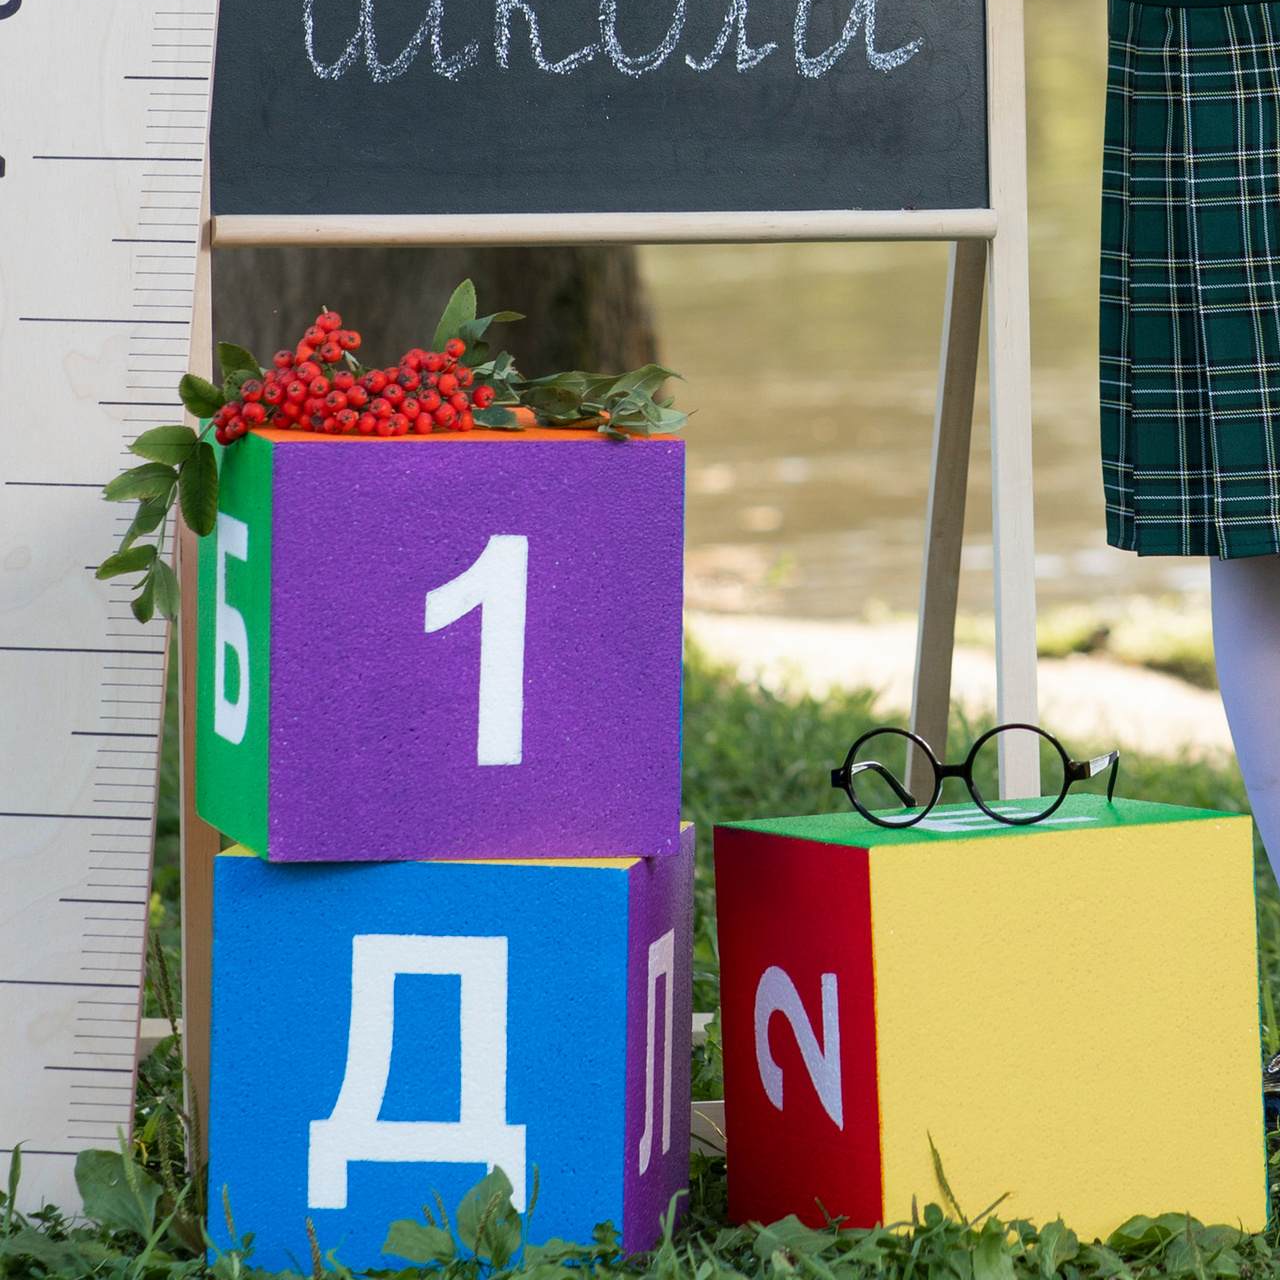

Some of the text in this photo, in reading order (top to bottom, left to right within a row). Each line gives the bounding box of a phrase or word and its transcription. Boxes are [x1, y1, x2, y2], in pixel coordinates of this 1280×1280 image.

[214, 513, 250, 745] Б
[425, 534, 528, 766] 1
[308, 933, 527, 1214] Д
[755, 966, 843, 1131] 2
